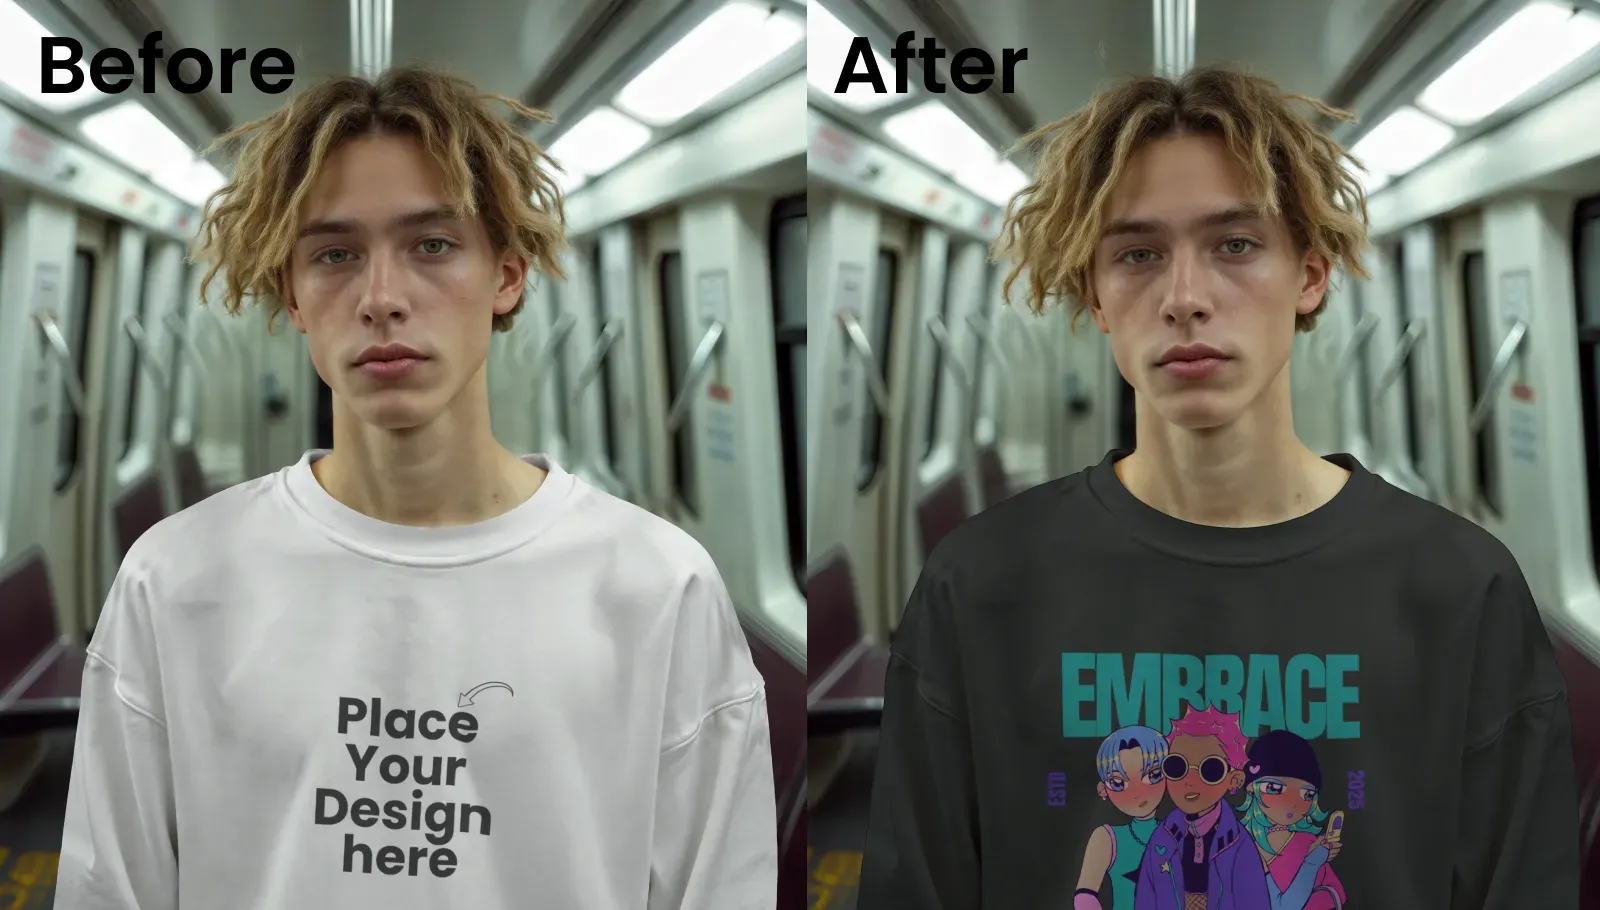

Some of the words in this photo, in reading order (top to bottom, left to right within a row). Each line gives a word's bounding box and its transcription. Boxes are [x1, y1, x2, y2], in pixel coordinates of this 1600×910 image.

[1061, 651, 1361, 740] EMBRACE
[337, 696, 479, 744] Place
[345, 743, 467, 786] Your
[1047, 771, 1066, 807] ESTD
[1347, 770, 1366, 810] 2025
[314, 787, 492, 846] Design
[342, 833, 458, 878] here
